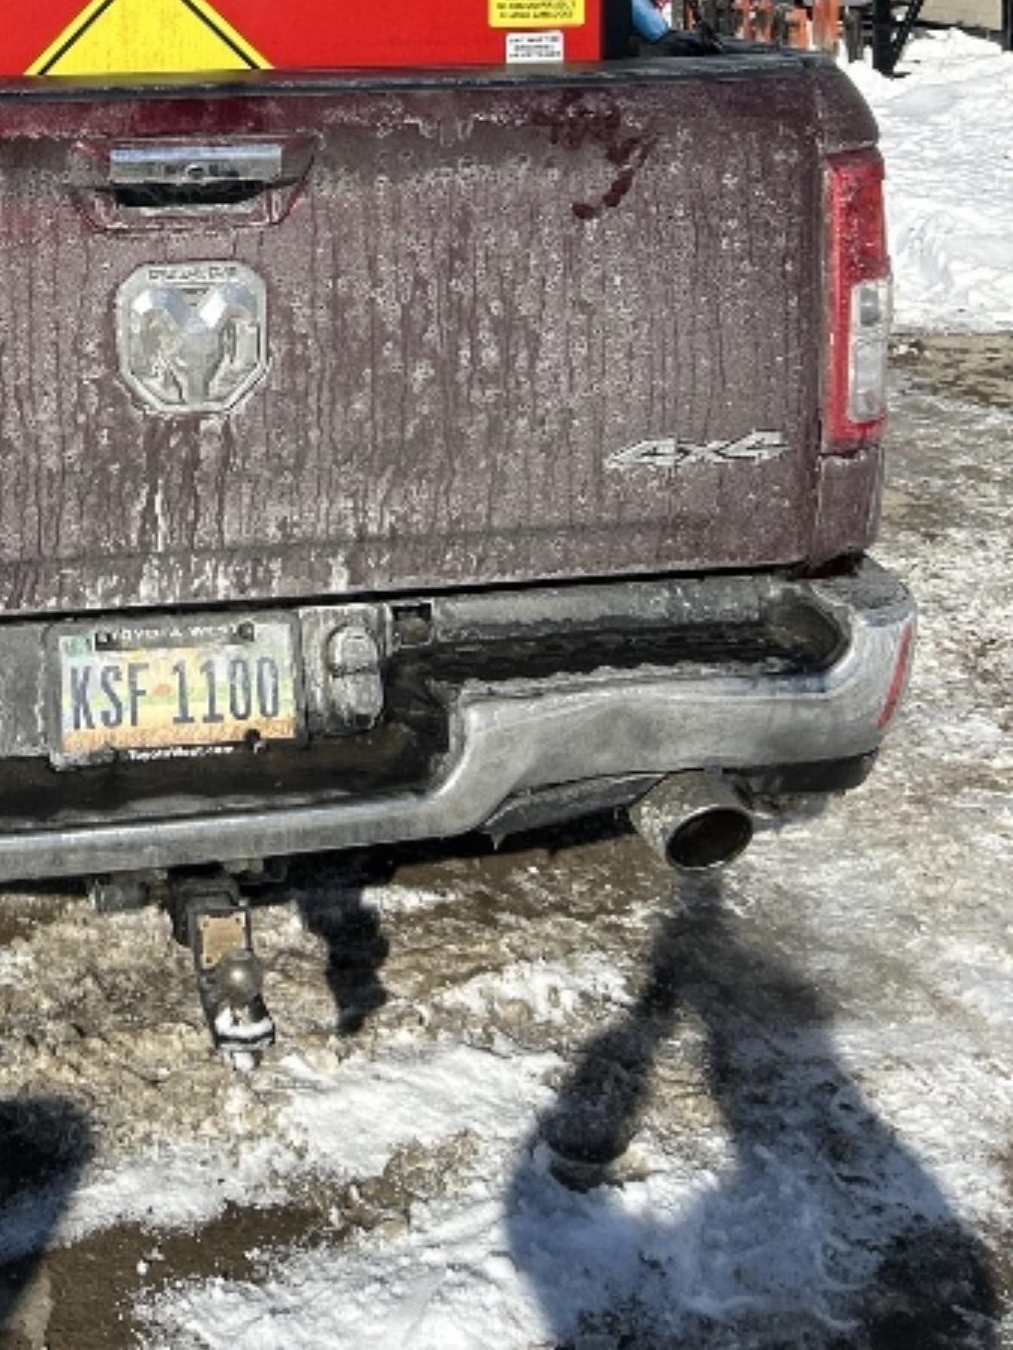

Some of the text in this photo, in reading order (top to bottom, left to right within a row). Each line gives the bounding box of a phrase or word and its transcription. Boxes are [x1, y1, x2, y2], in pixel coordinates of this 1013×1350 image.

[111, 627, 183, 642] TOYOA
[70, 656, 280, 730] KSF 1100
